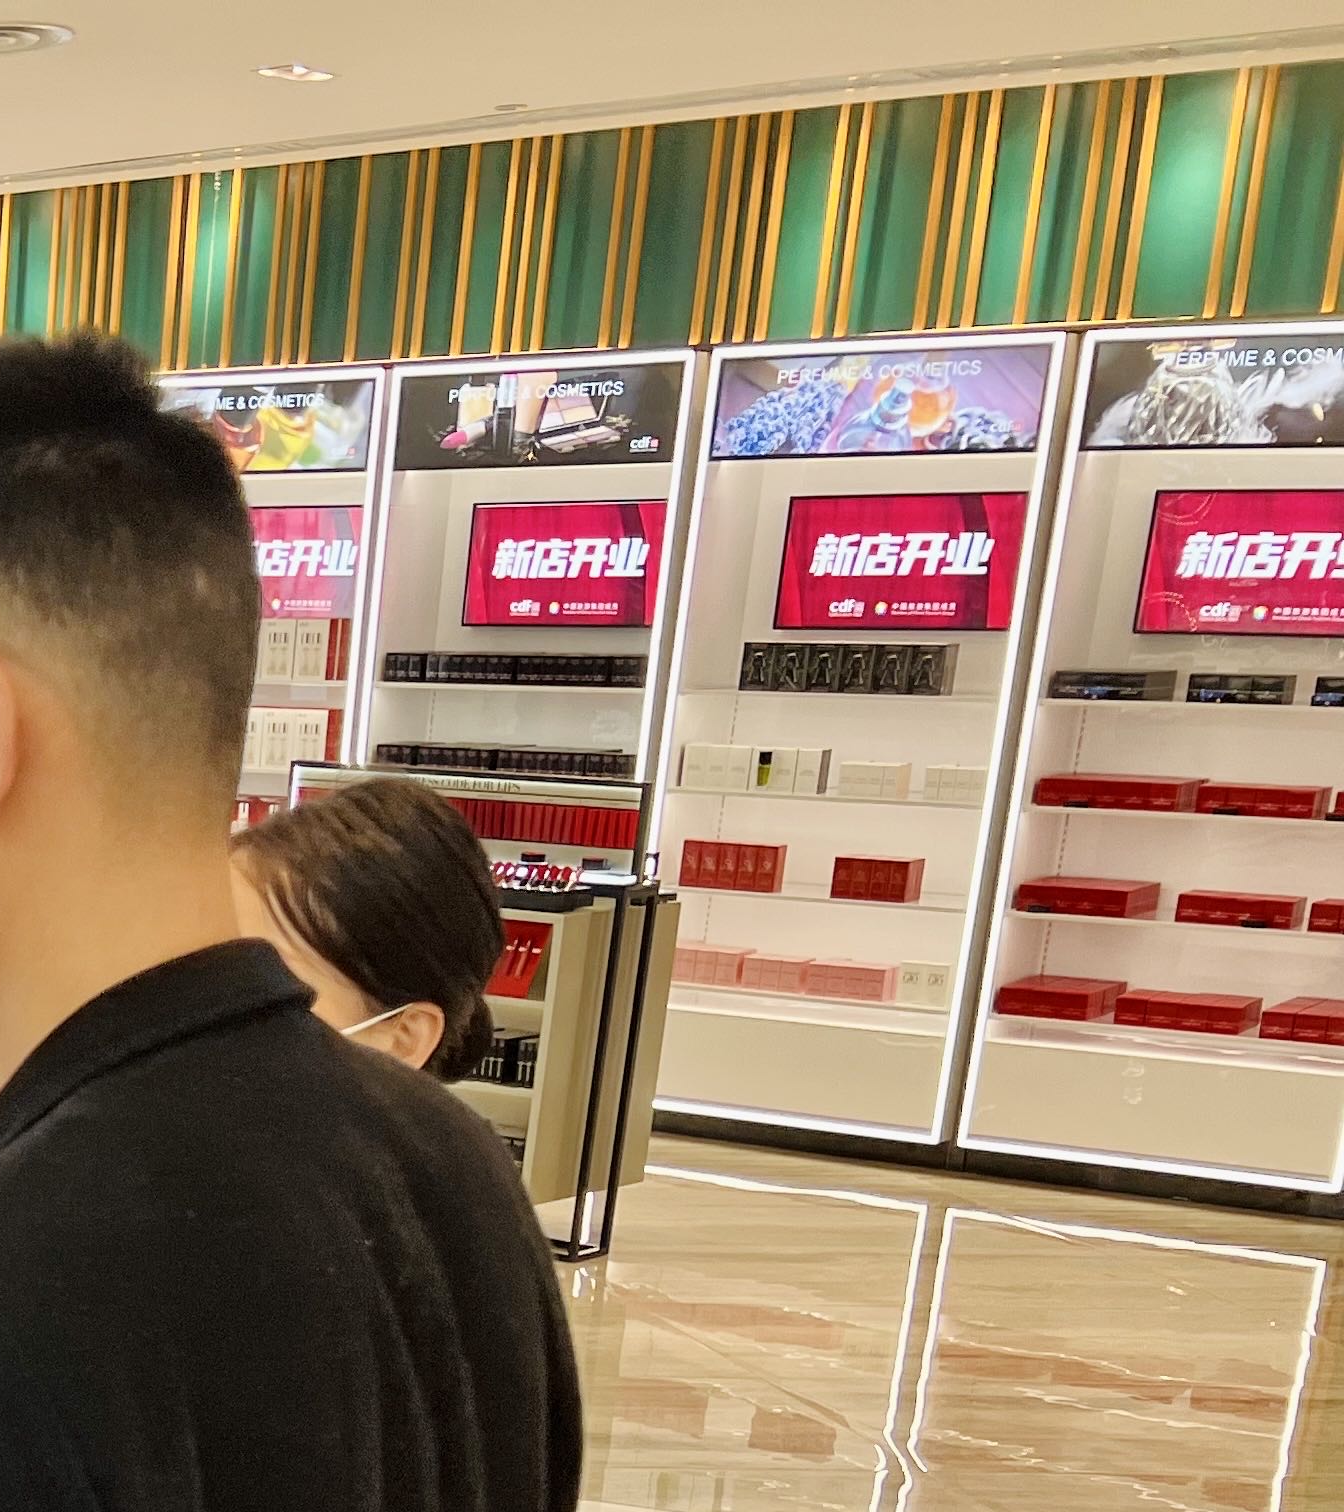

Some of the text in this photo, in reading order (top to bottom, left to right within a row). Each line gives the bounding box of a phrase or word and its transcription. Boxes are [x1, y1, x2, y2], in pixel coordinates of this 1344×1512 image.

[1262, 348, 1277, 366] &
[1282, 347, 1344, 366] COSM
[864, 366, 874, 380] &
[878, 359, 982, 380] COSMETICS
[535, 380, 624, 400] COSMETICS
[253, 539, 359, 577] 店开业
[491, 537, 650, 579] 新店开业
[809, 532, 996, 577] 新店开业
[829, 598, 856, 614] cdf
[1199, 601, 1231, 618] cdf
